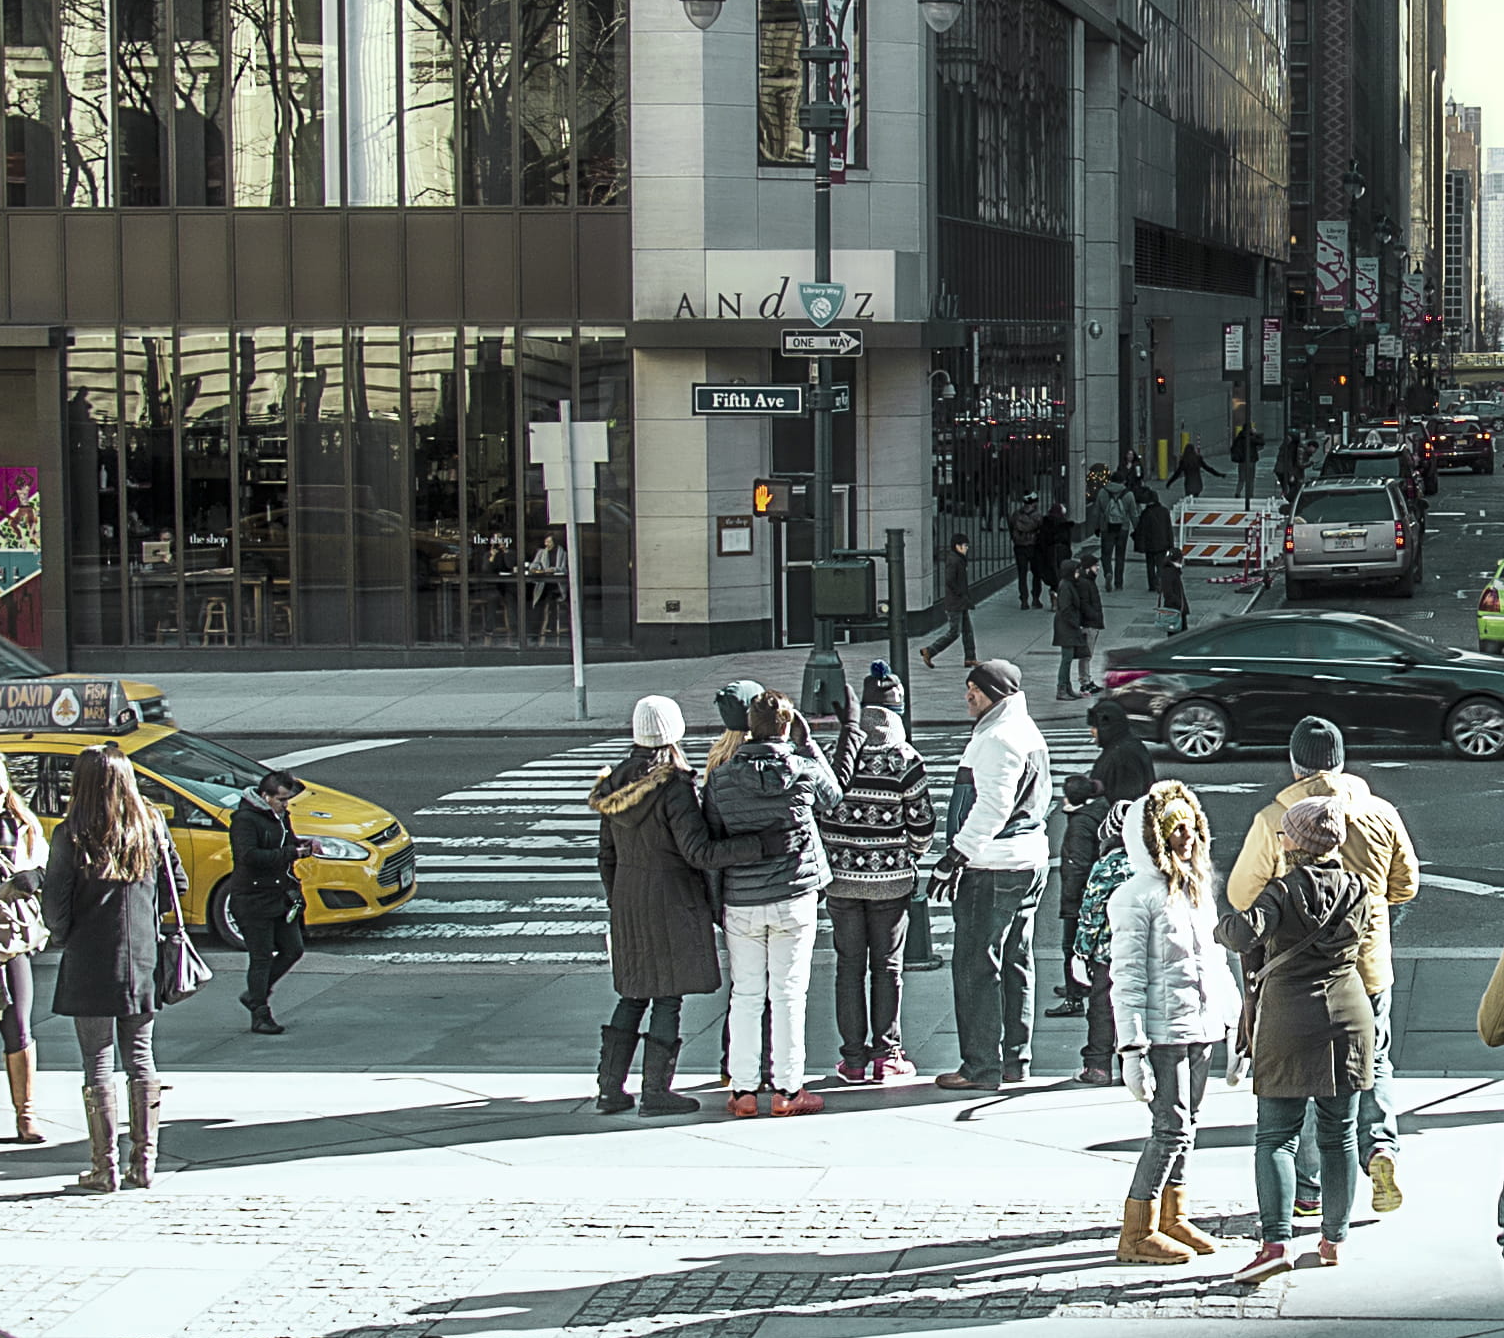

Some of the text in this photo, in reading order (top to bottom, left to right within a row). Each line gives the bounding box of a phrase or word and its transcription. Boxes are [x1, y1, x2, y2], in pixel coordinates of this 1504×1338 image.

[802, 287, 841, 296] Library Way
[793, 338, 851, 348] ONE WAY
[712, 392, 785, 408] Fifth Ave
[473, 534, 513, 548] the shop
[8, 684, 53, 707] DAVID
